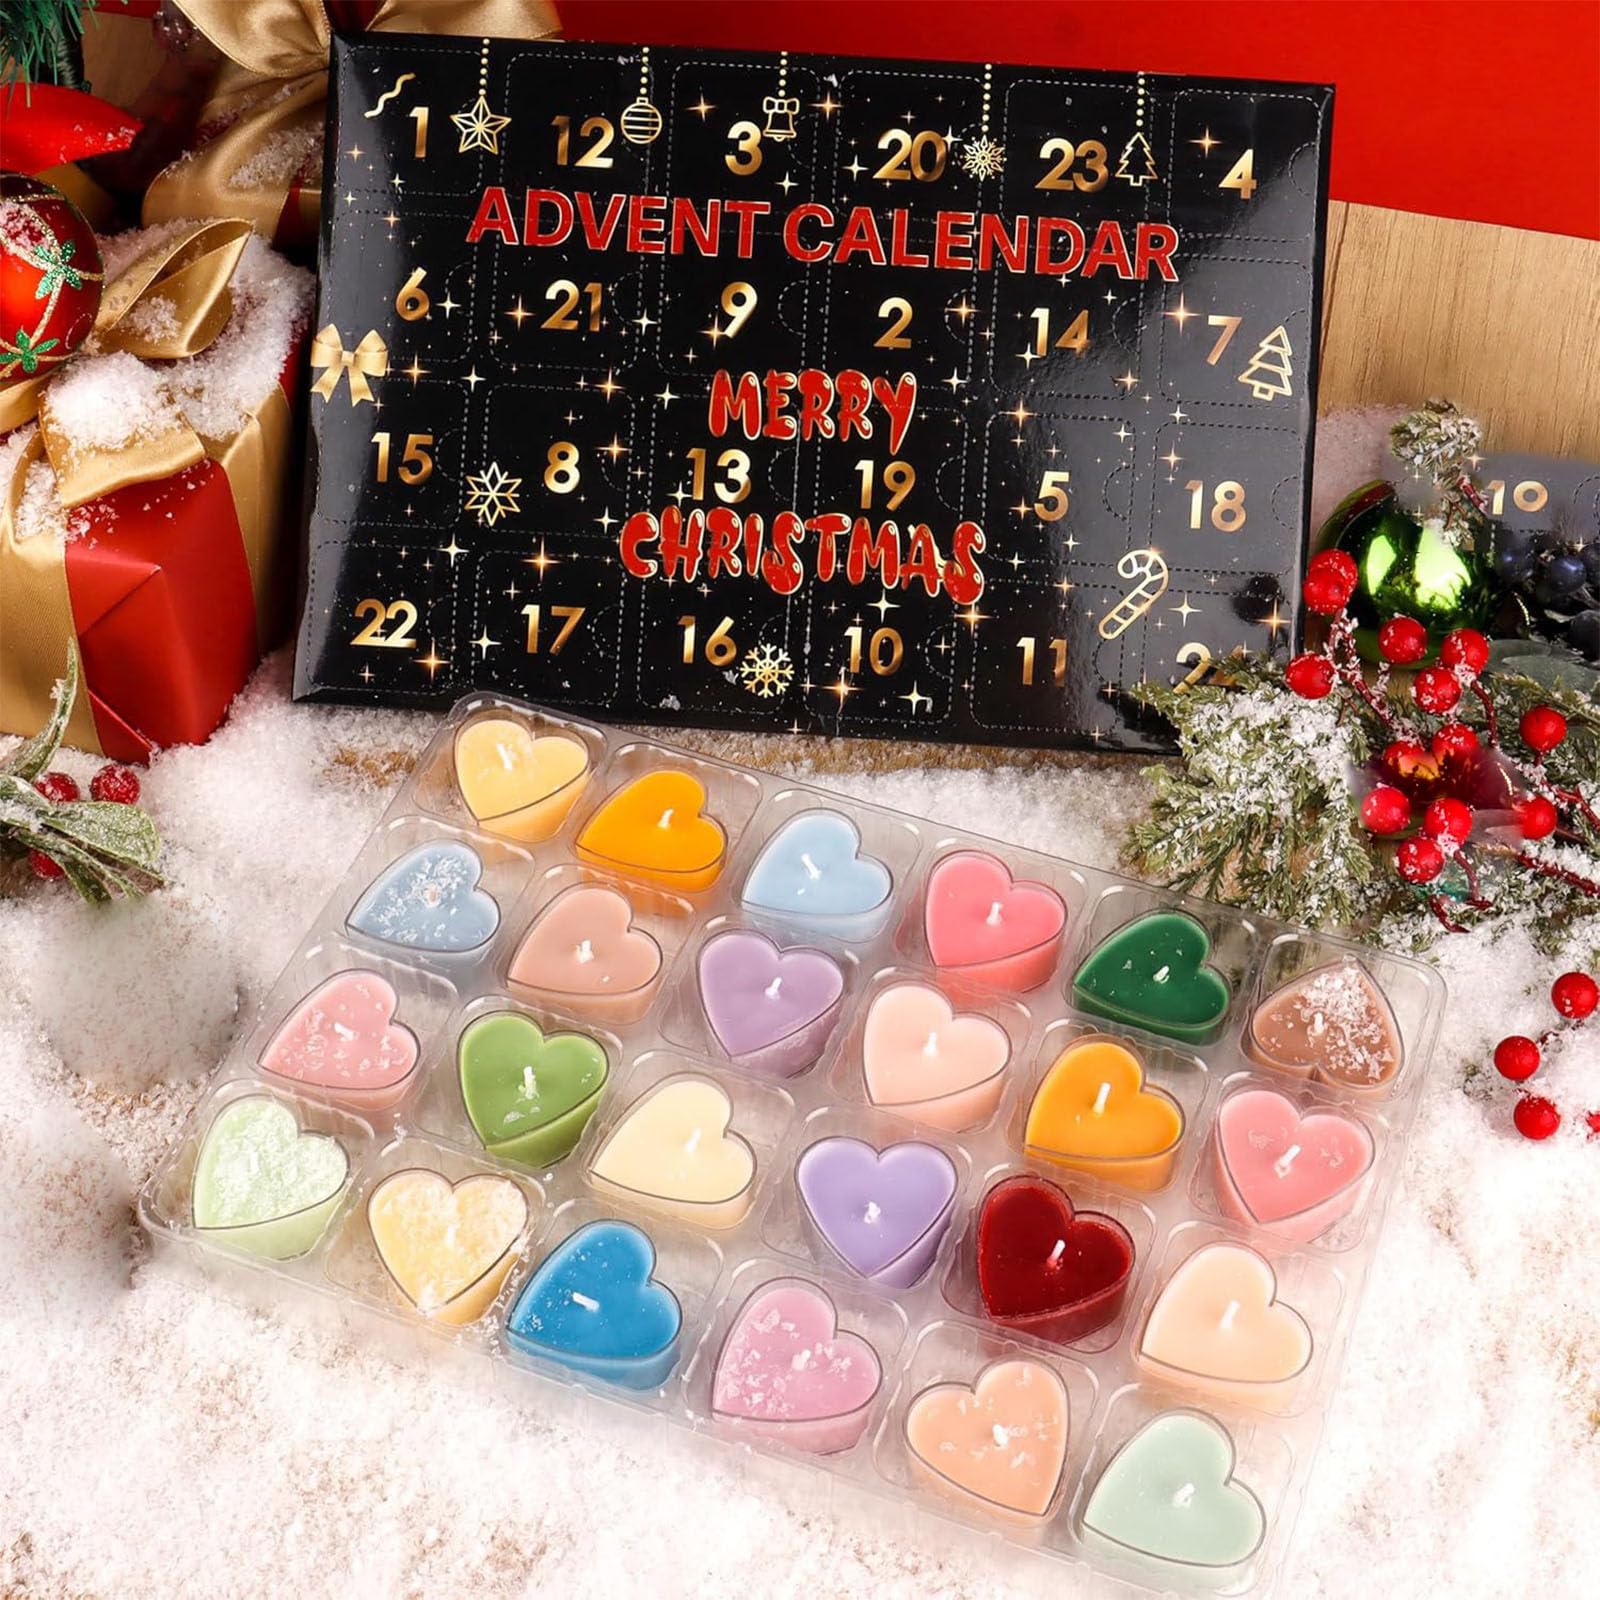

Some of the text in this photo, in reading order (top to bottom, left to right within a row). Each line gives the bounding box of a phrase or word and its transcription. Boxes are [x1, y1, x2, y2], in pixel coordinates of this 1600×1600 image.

[409, 106, 429, 158] 1
[551, 116, 615, 168] 12
[725, 121, 763, 175] 3
[872, 129, 946, 182] 20
[1035, 138, 1108, 192] 23
[1219, 149, 1256, 199] 4
[465, 186, 1179, 281] ADVENT CALENDAR
[395, 267, 430, 321] 6
[541, 280, 602, 332] 21
[721, 282, 757, 338] 9
[875, 297, 913, 349] 2
[1030, 307, 1090, 358] 14
[1208, 314, 1241, 366] 7
[708, 368, 917, 455] MERRY
[371, 432, 434, 485] 15
[544, 441, 580, 494] 8
[686, 448, 751, 503] 13
[854, 459, 916, 512] 19
[1034, 471, 1069, 521] 5
[1184, 480, 1246, 532] 18
[1487, 480, 1548, 515] 10
[620, 505, 986, 605] CHRISTMAS
[351, 599, 418, 649] 22
[521, 604, 586, 656] 17
[677, 615, 737, 666] 16
[844, 626, 904, 676] 10
[1017, 637, 1067, 687] 11
